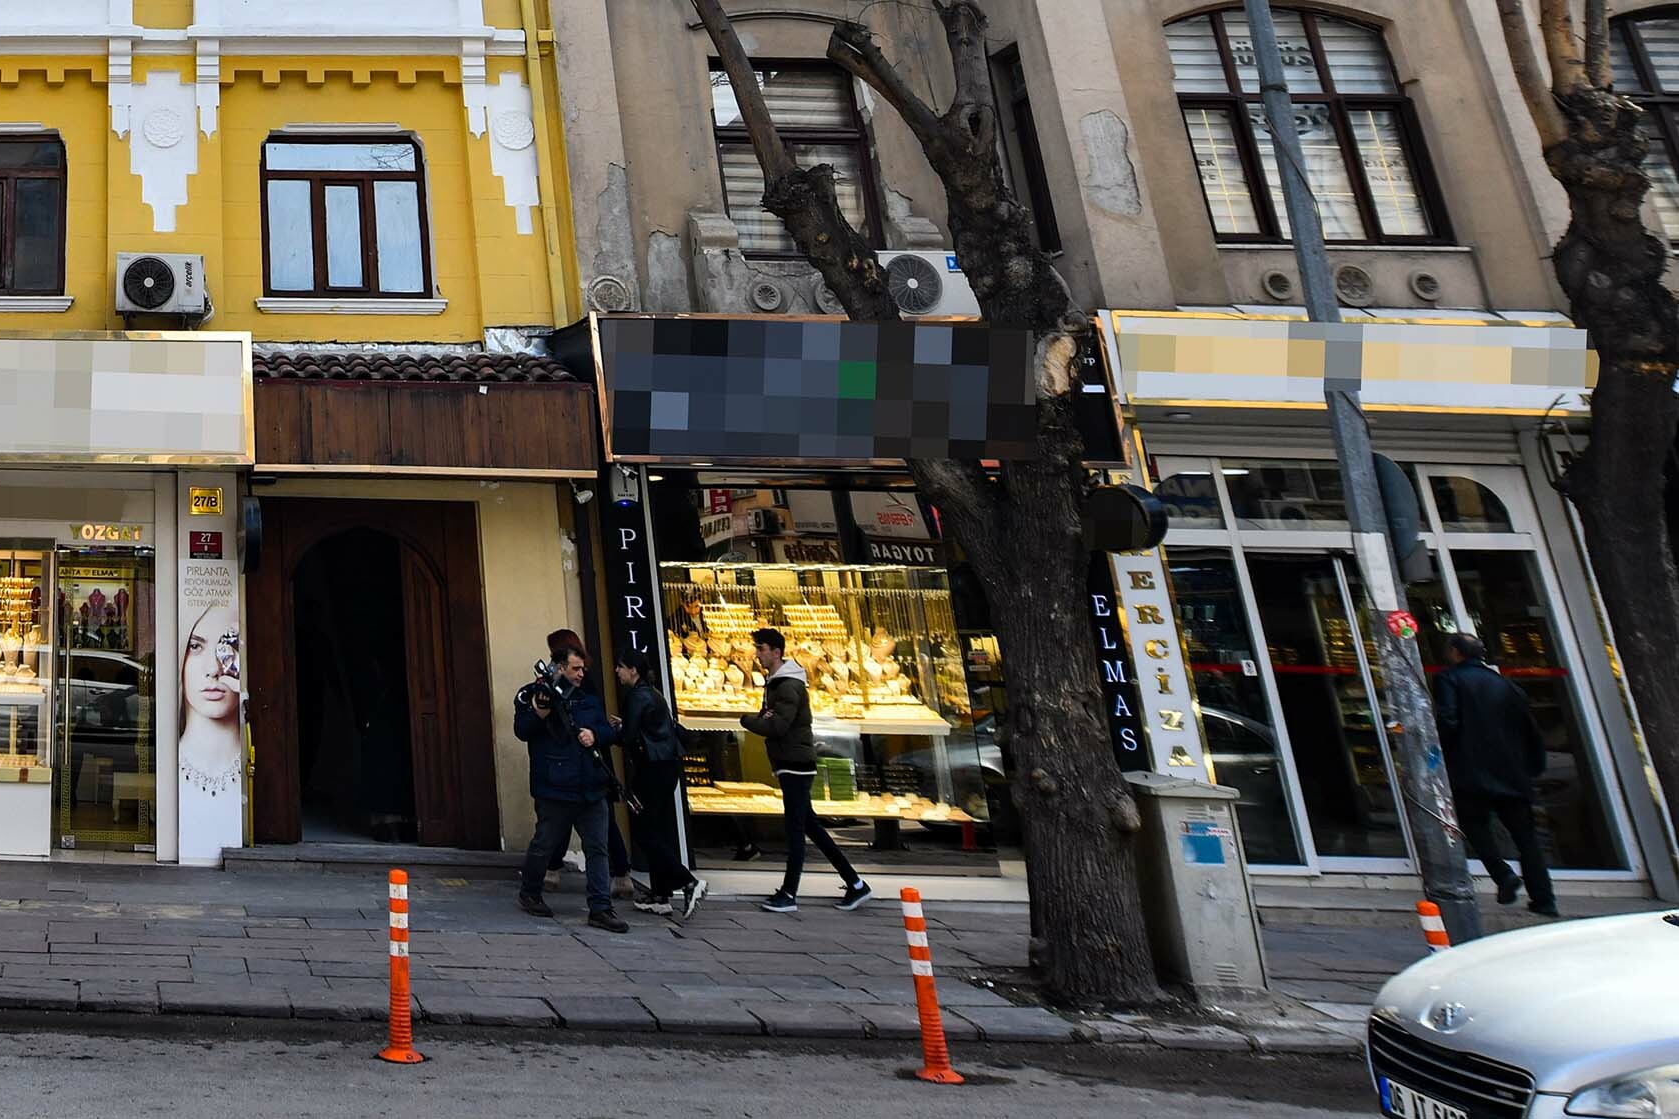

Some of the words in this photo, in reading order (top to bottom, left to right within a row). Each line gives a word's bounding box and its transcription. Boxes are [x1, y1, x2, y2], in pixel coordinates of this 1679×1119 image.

[193, 496, 218, 507] 27/B
[69, 524, 142, 540] YOZGAT
[200, 533, 211, 543] 27
[186, 566, 230, 576] PIRLANTA
[205, 588, 233, 598] ATMAK
[1091, 594, 1138, 752] ELMAS
